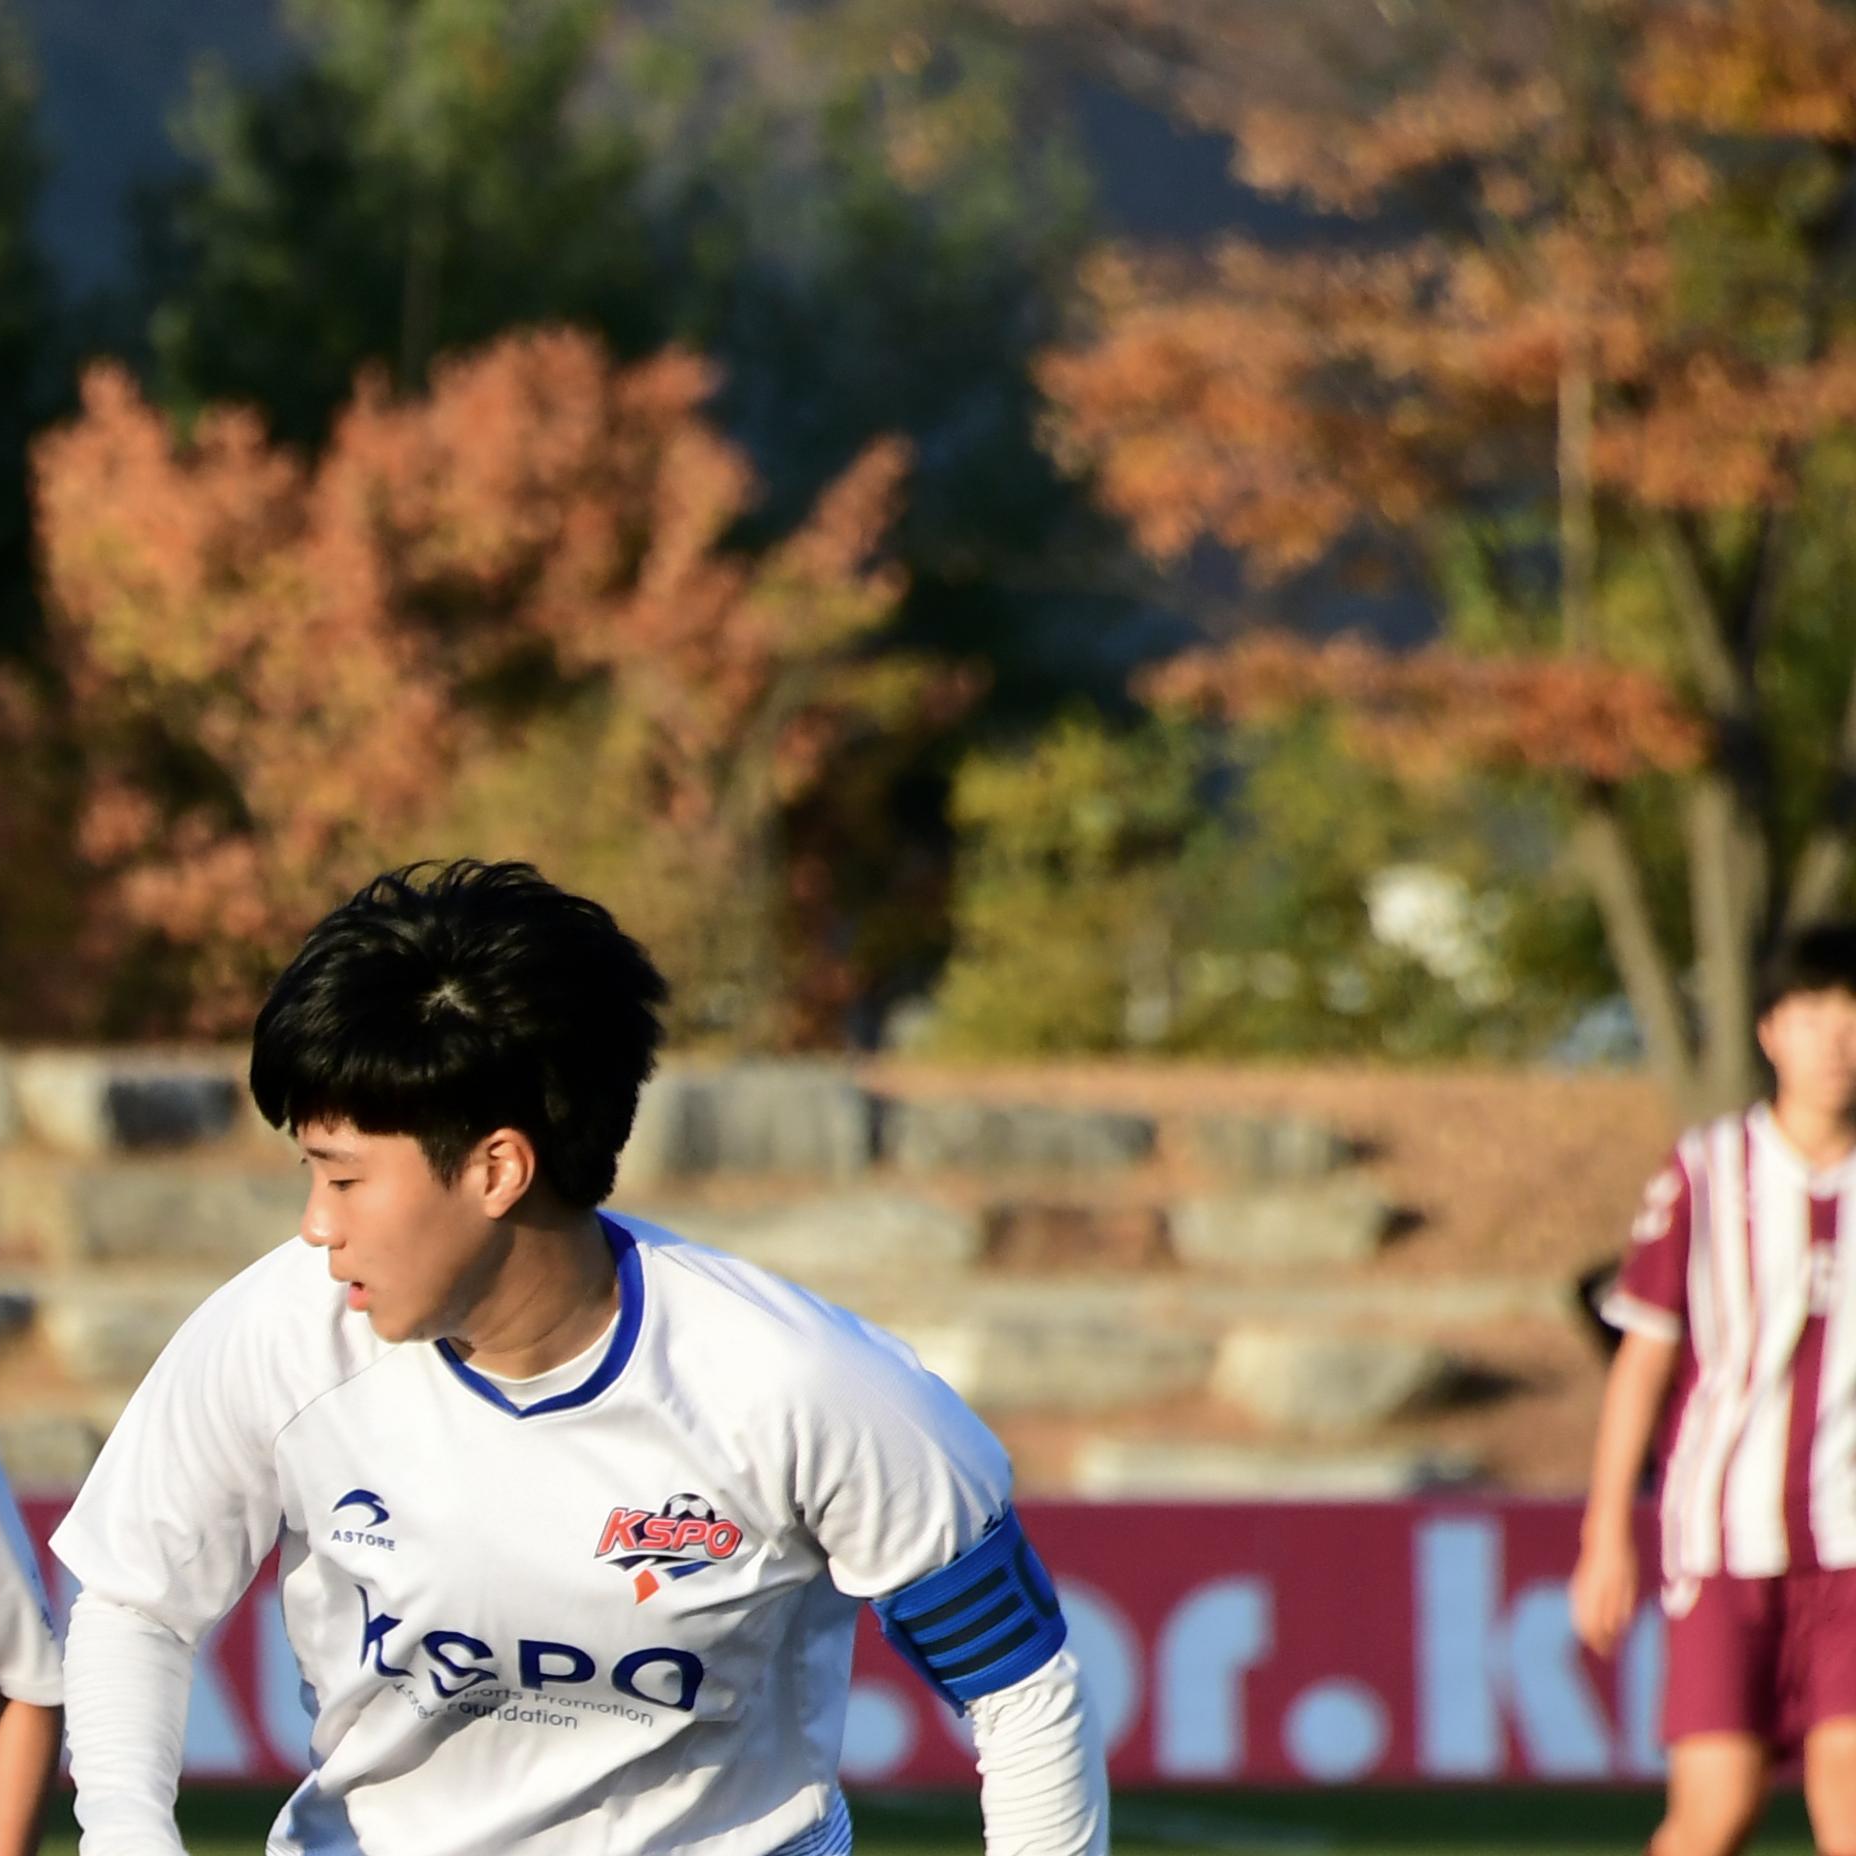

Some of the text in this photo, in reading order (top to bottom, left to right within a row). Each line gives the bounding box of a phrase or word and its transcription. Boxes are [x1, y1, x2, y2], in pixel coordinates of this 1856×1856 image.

[331, 1529, 396, 1551] ASTORE
[594, 1507, 743, 1559] KSPO
[355, 1583, 705, 1712] KSPO
